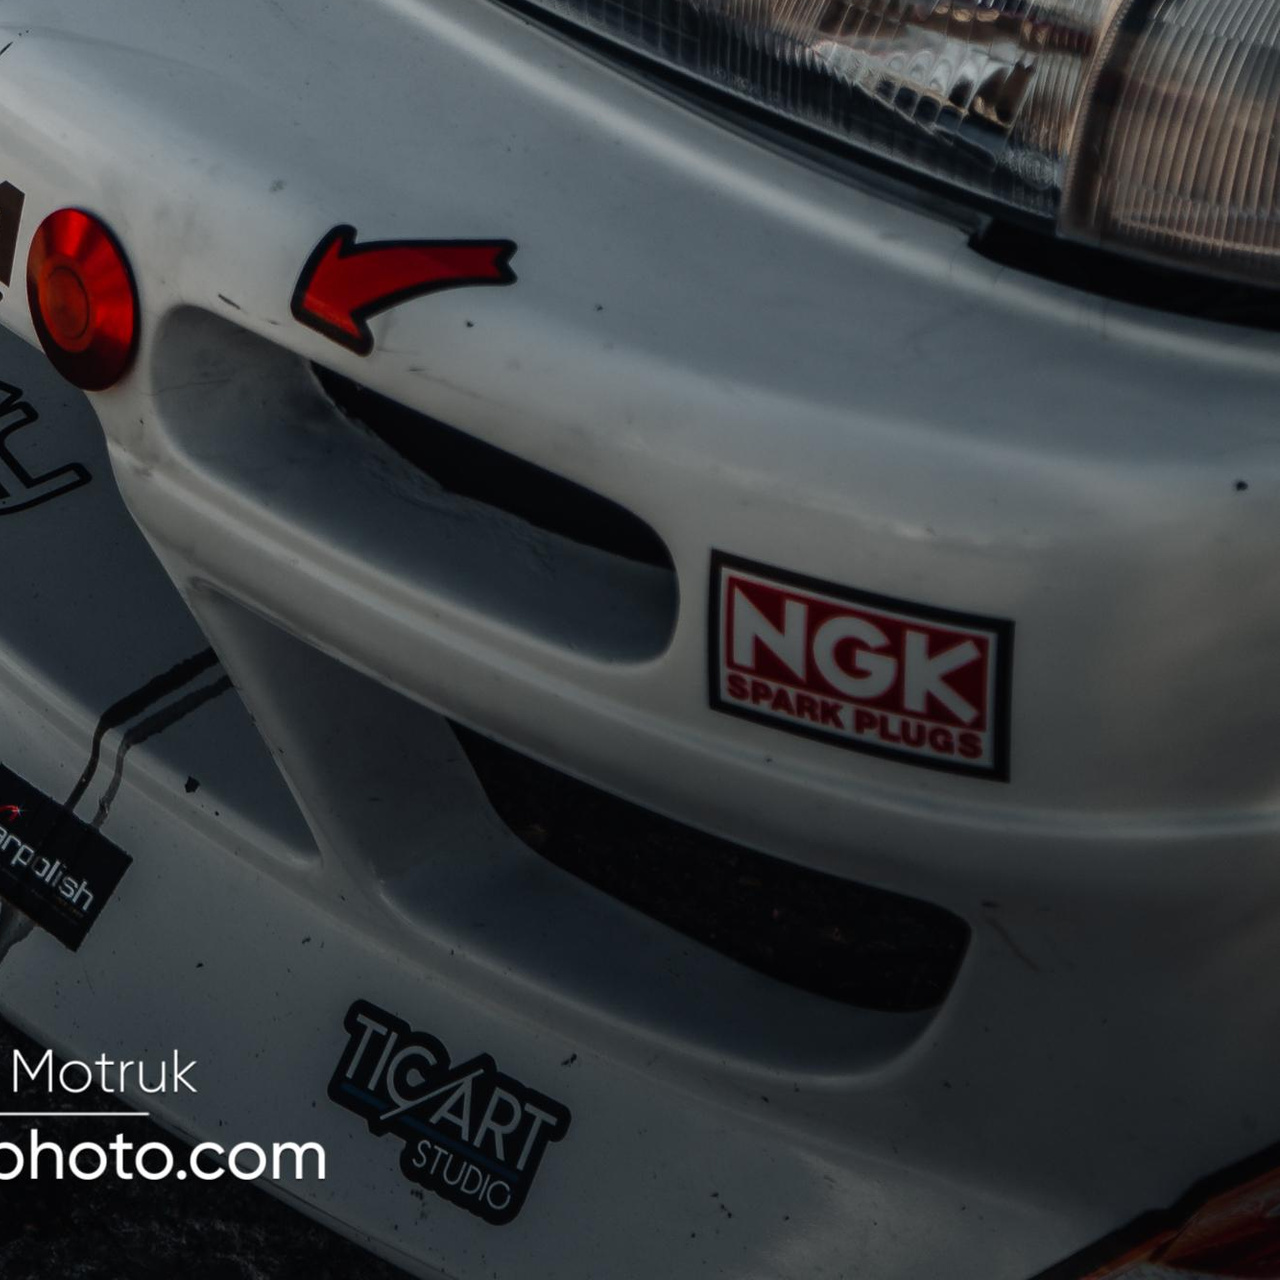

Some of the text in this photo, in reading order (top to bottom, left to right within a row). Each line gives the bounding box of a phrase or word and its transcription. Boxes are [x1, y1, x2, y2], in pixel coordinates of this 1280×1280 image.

[727, 582, 983, 725] NGK
[726, 671, 983, 761] SPARK PLUGS
[412, 1139, 512, 1210] STUDIO
